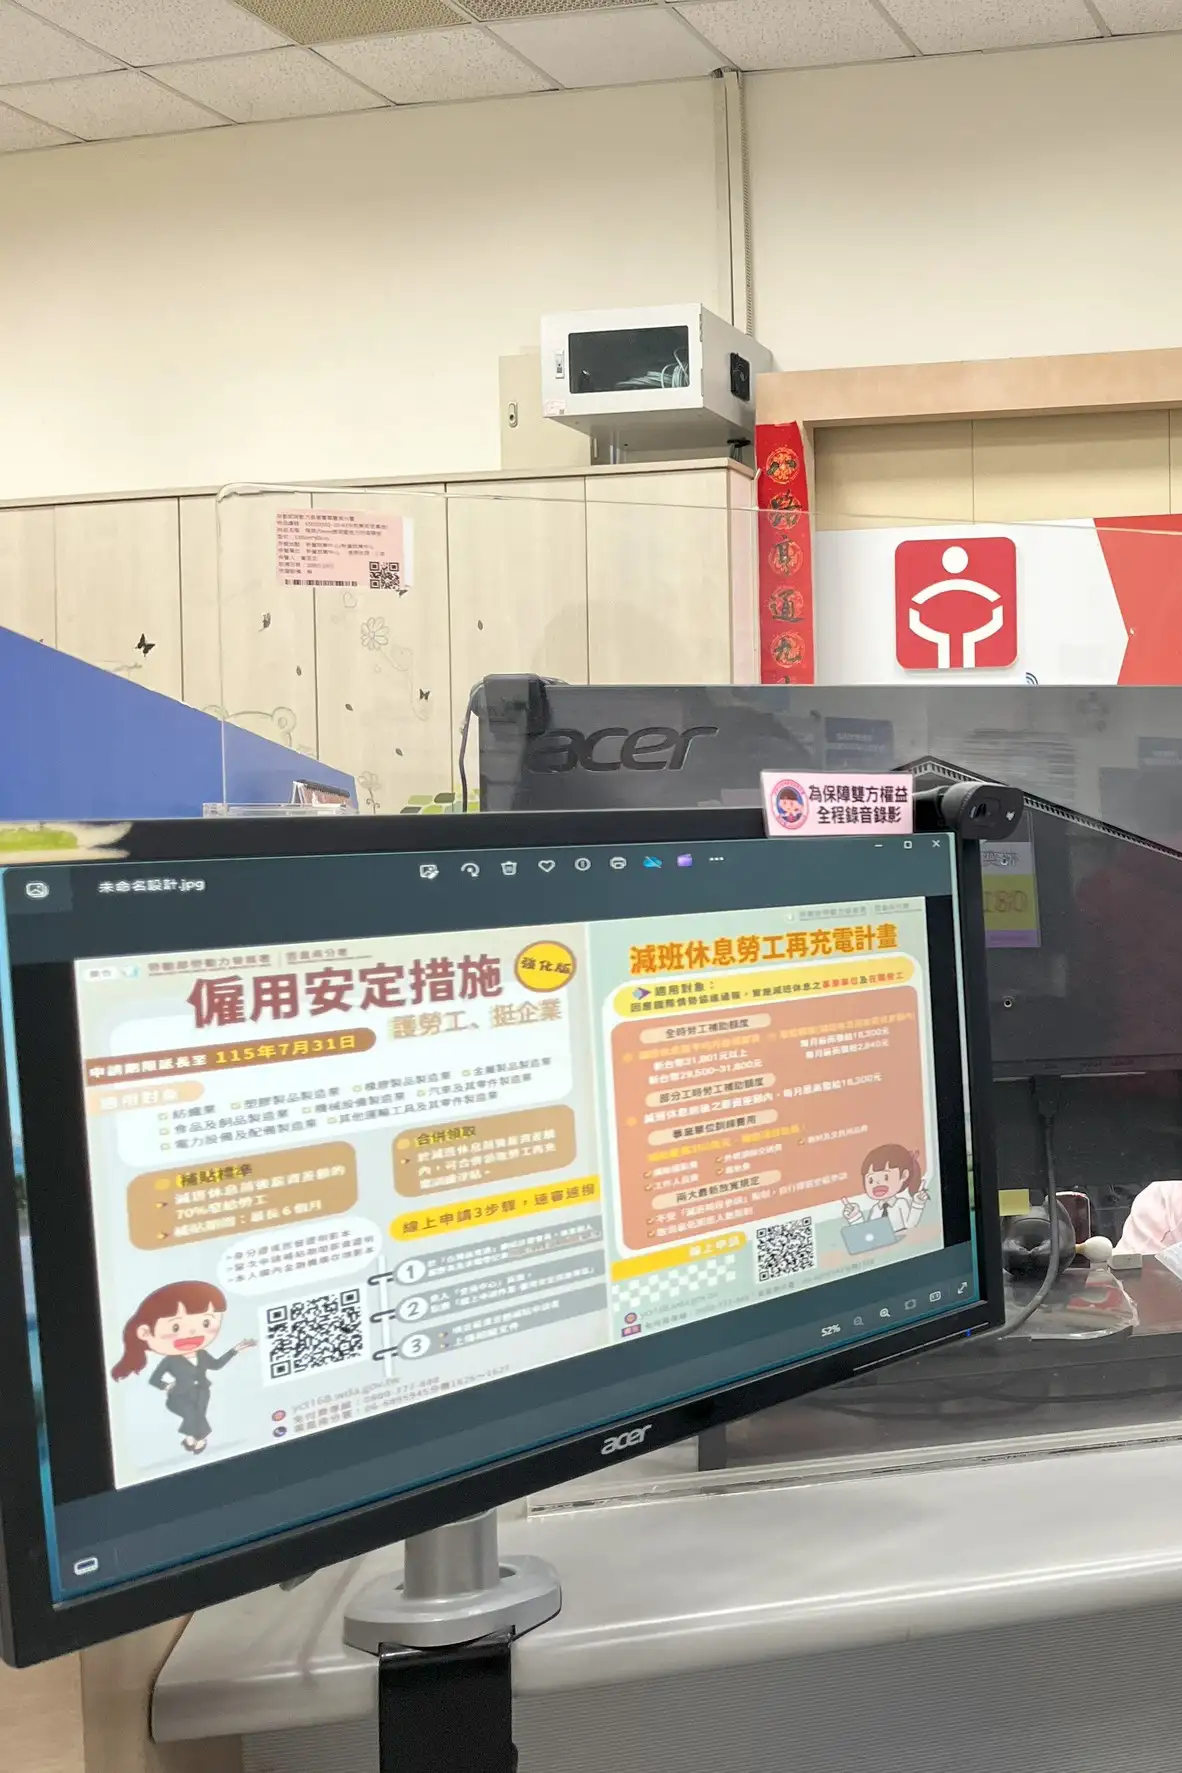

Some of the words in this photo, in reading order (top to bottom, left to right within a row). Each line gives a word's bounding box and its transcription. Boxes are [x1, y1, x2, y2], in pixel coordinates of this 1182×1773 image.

[526, 726, 720, 774] acer
[808, 785, 909, 804] 為保障雙方權益
[817, 806, 902, 825] 全程錄音錄影
[98, 878, 206, 893] 未命名設計.jpg
[629, 923, 898, 974] 減班休息勞工再充電計畫
[520, 956, 571, 975] 強化版
[187, 954, 503, 1028] 僱用安定措施
[216, 1035, 355, 1064] 115年7月31日
[405, 1264, 415, 1279] 1
[407, 1302, 419, 1317] 2
[821, 1323, 841, 1337] 52%
[411, 1338, 422, 1353] 3
[600, 1424, 653, 1455] acer
